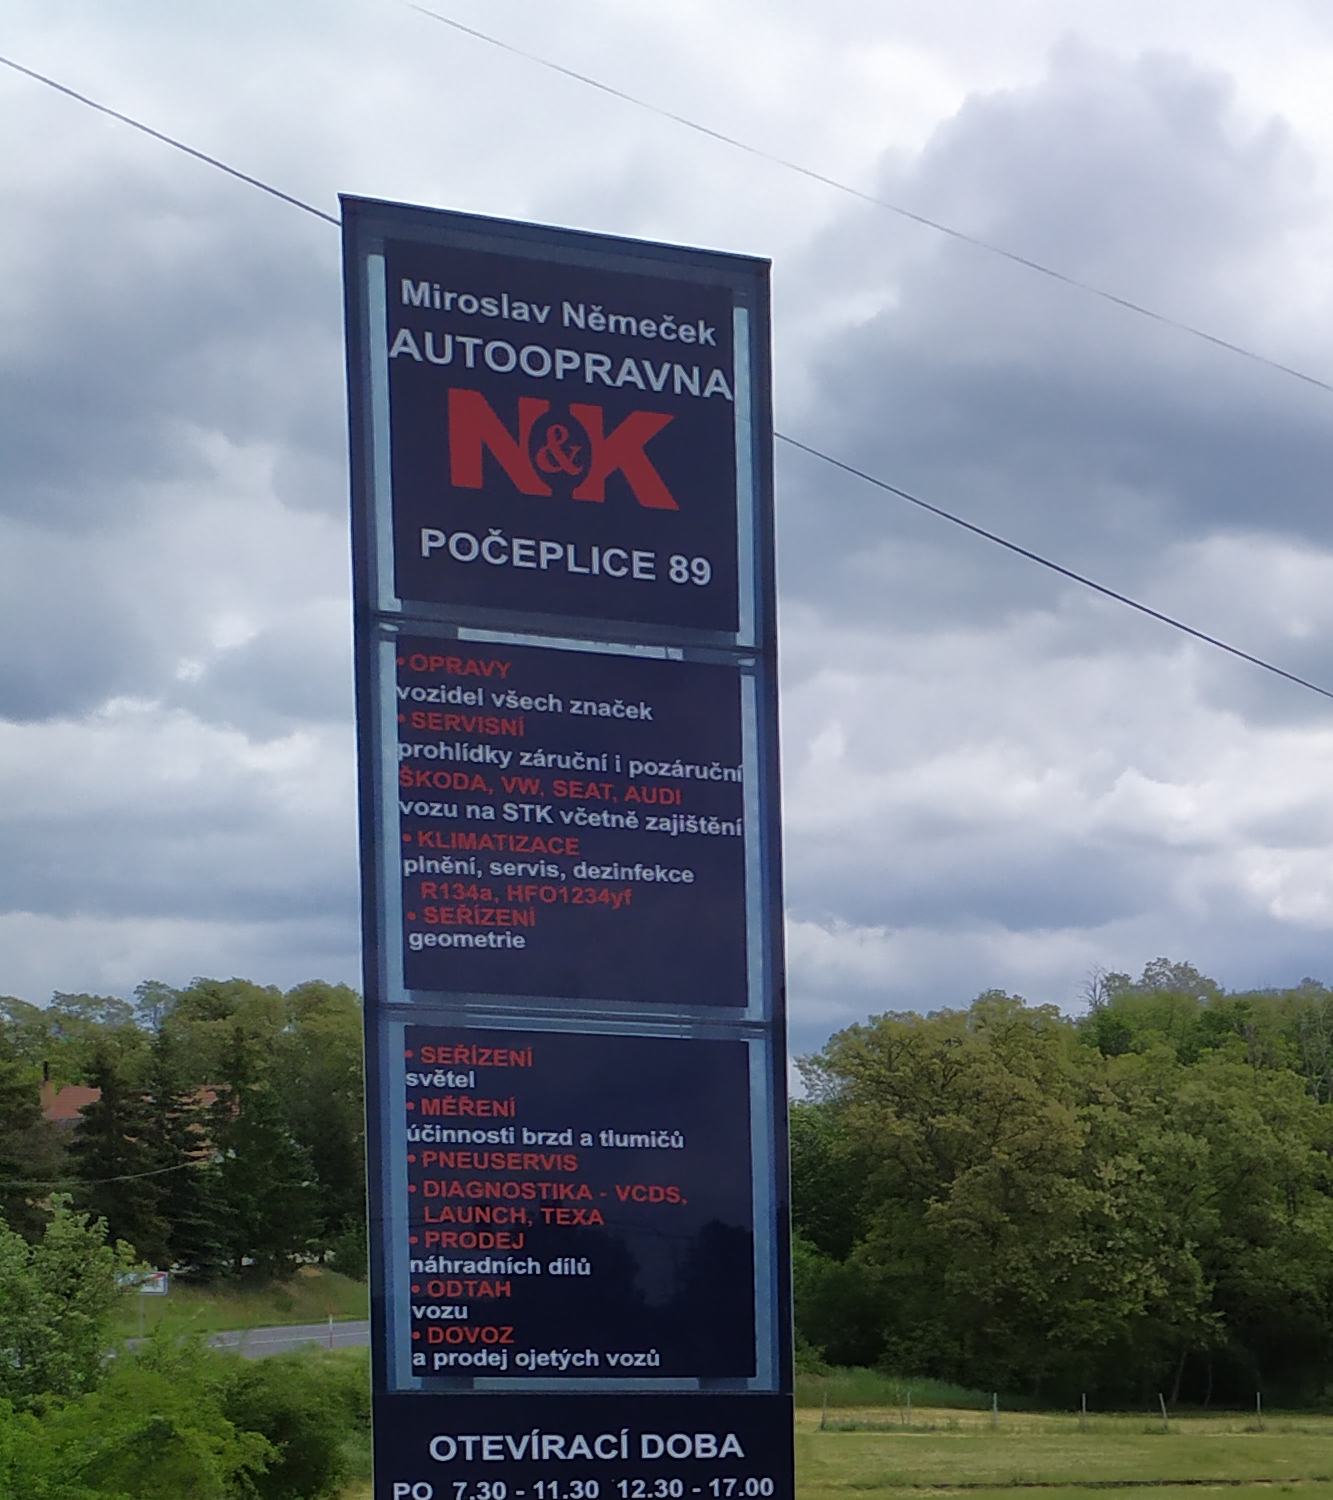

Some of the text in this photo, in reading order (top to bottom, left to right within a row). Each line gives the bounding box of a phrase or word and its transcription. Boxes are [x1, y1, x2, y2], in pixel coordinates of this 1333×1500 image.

[401, 279, 717, 348] Miroslav Němeček
[389, 328, 733, 401] AUTOOPRAVNA
[448, 387, 680, 511] N&K
[421, 527, 712, 587] POČEPLICE 89
[409, 653, 511, 678] OPRAVY
[397, 683, 654, 721] vozidel všech značek
[412, 711, 525, 737] SERVISNÍ
[398, 742, 743, 783] prohlídky záruční i pozáruční
[625, 785, 681, 806] AUDI
[399, 800, 742, 838] vozu na STK včetně zajištění
[418, 831, 580, 856] KLIMATIZACE
[403, 855, 695, 884] plnění, servis, dezinfekce
[423, 904, 536, 927] SEŘÍZENÍ
[408, 929, 526, 951] geometrie
[421, 1044, 533, 1068] SEŘÍZENÍ
[405, 1069, 476, 1088] světel
[421, 1094, 516, 1118] MĚŘENÍ
[407, 1126, 685, 1149] účinnosti brzd a tlumičů
[422, 1151, 579, 1171] PNEUSERVIS
[423, 1180, 593, 1201] DIAGNOSTIKA
[424, 1206, 605, 1226] LAUNCH, TEXA
[425, 1231, 526, 1249] PRODEJ
[410, 1256, 591, 1276] náhradních dílů
[427, 1280, 512, 1298] ODTAH
[413, 1304, 469, 1320] vozu
[428, 1325, 515, 1344] DOVOZ
[413, 1349, 660, 1371] a prodej ojetých vozů
[429, 1428, 745, 1462] OTEVÍRACÍ DOBA
[533, 1479, 599, 1500] 11.30
[617, 1478, 684, 1499] 12.30
[708, 1477, 774, 1497] 17.00
